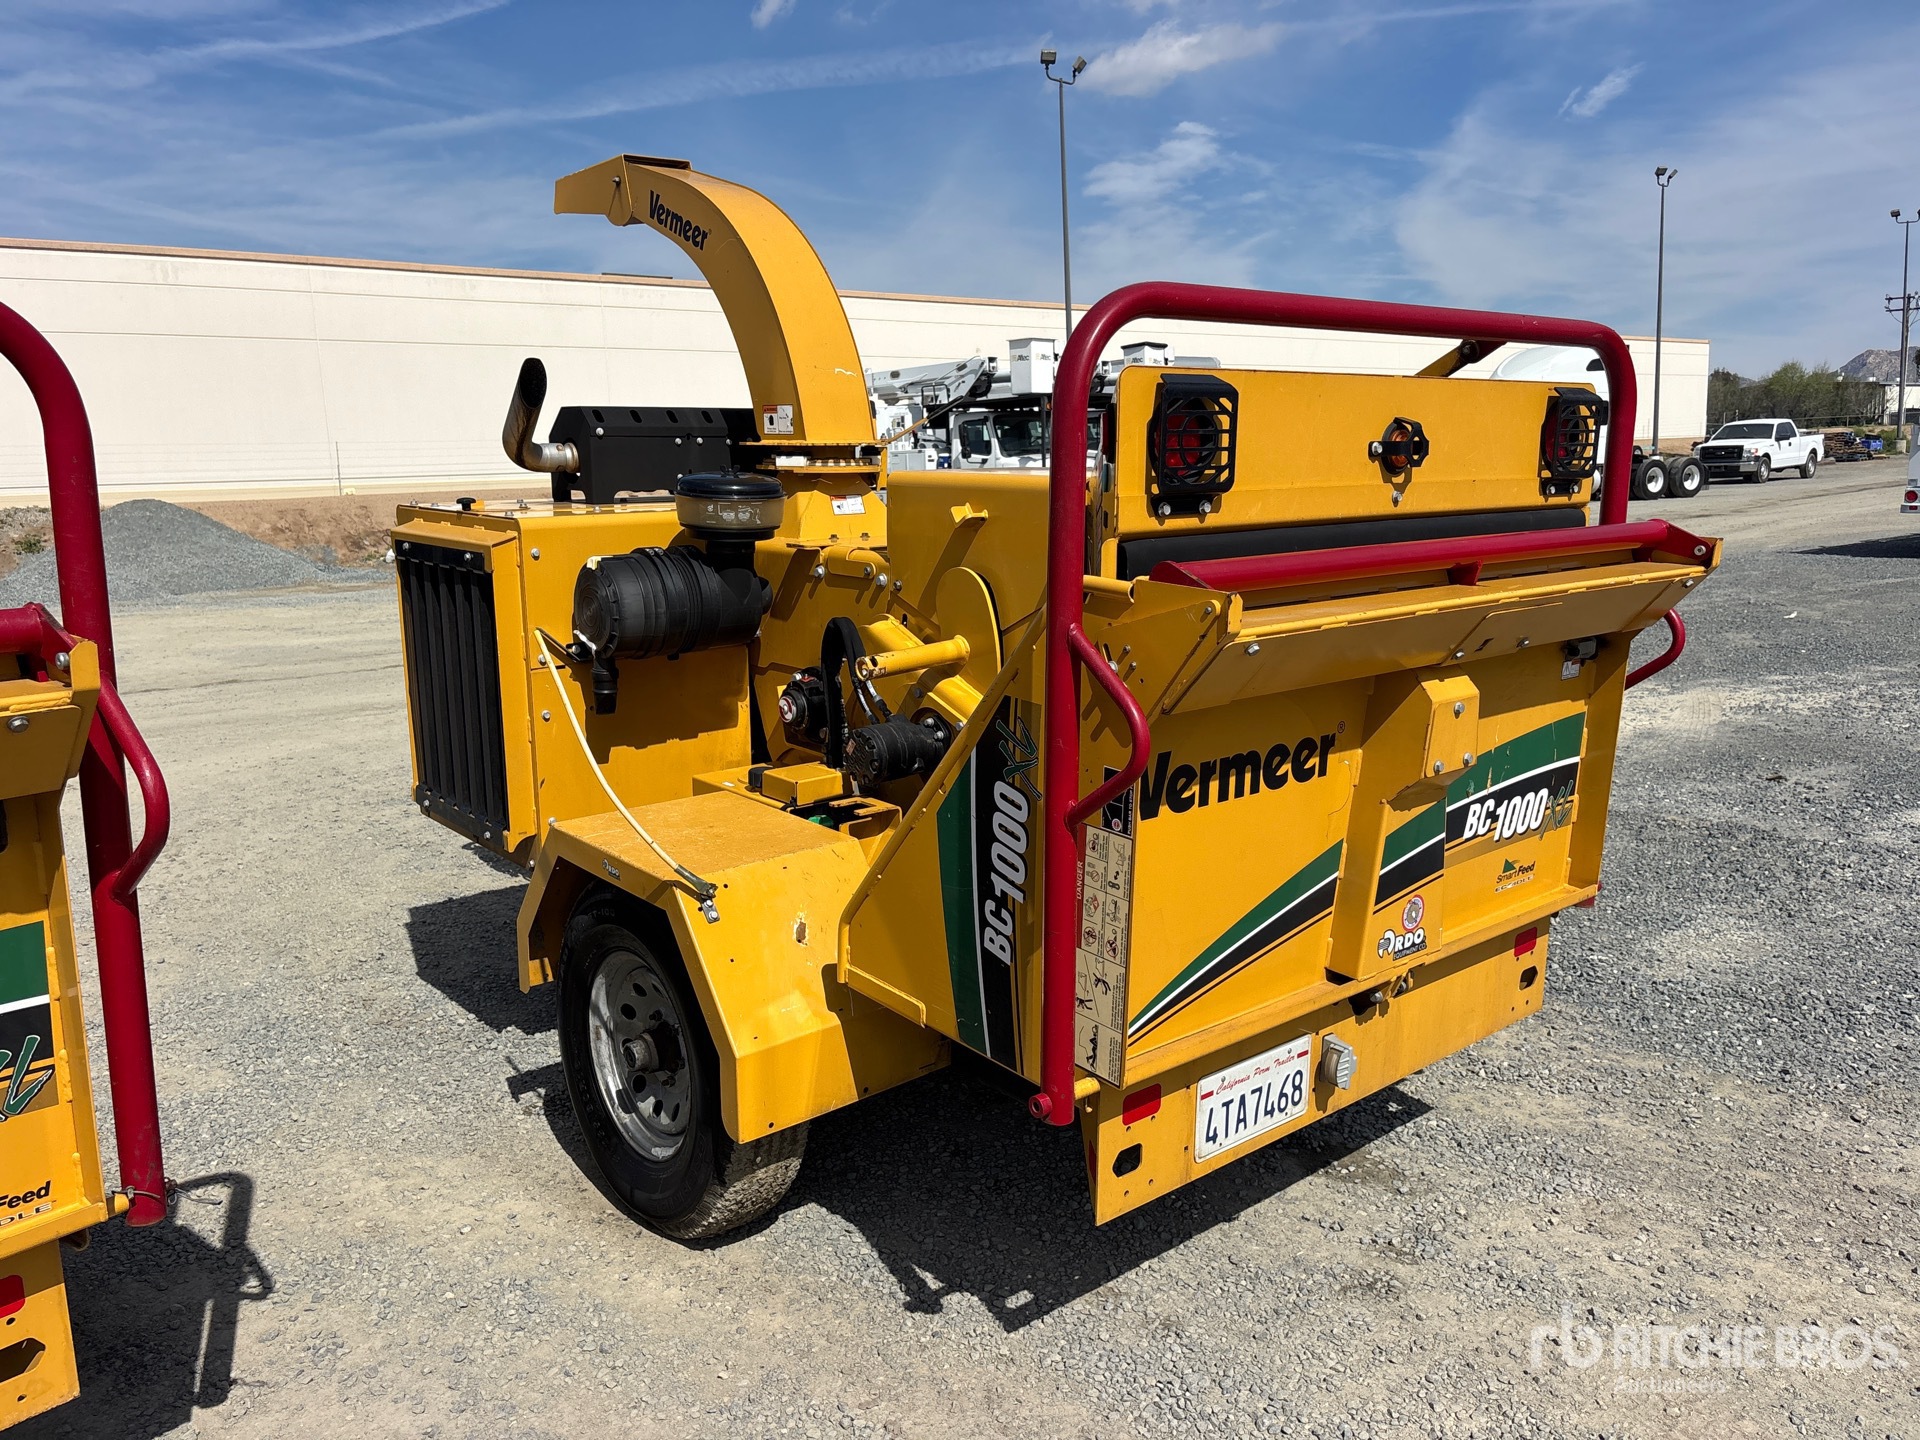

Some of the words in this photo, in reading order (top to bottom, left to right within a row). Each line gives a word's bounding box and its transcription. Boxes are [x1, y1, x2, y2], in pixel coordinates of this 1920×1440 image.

[649, 189, 708, 251] Vermeer
[1139, 732, 1337, 821] Vermeer
[1076, 861, 1084, 900] DANGER
[1216, 1074, 1251, 1095] California
[1273, 1055, 1295, 1069] Trailer
[1205, 1069, 1304, 1145] 4TA7468
